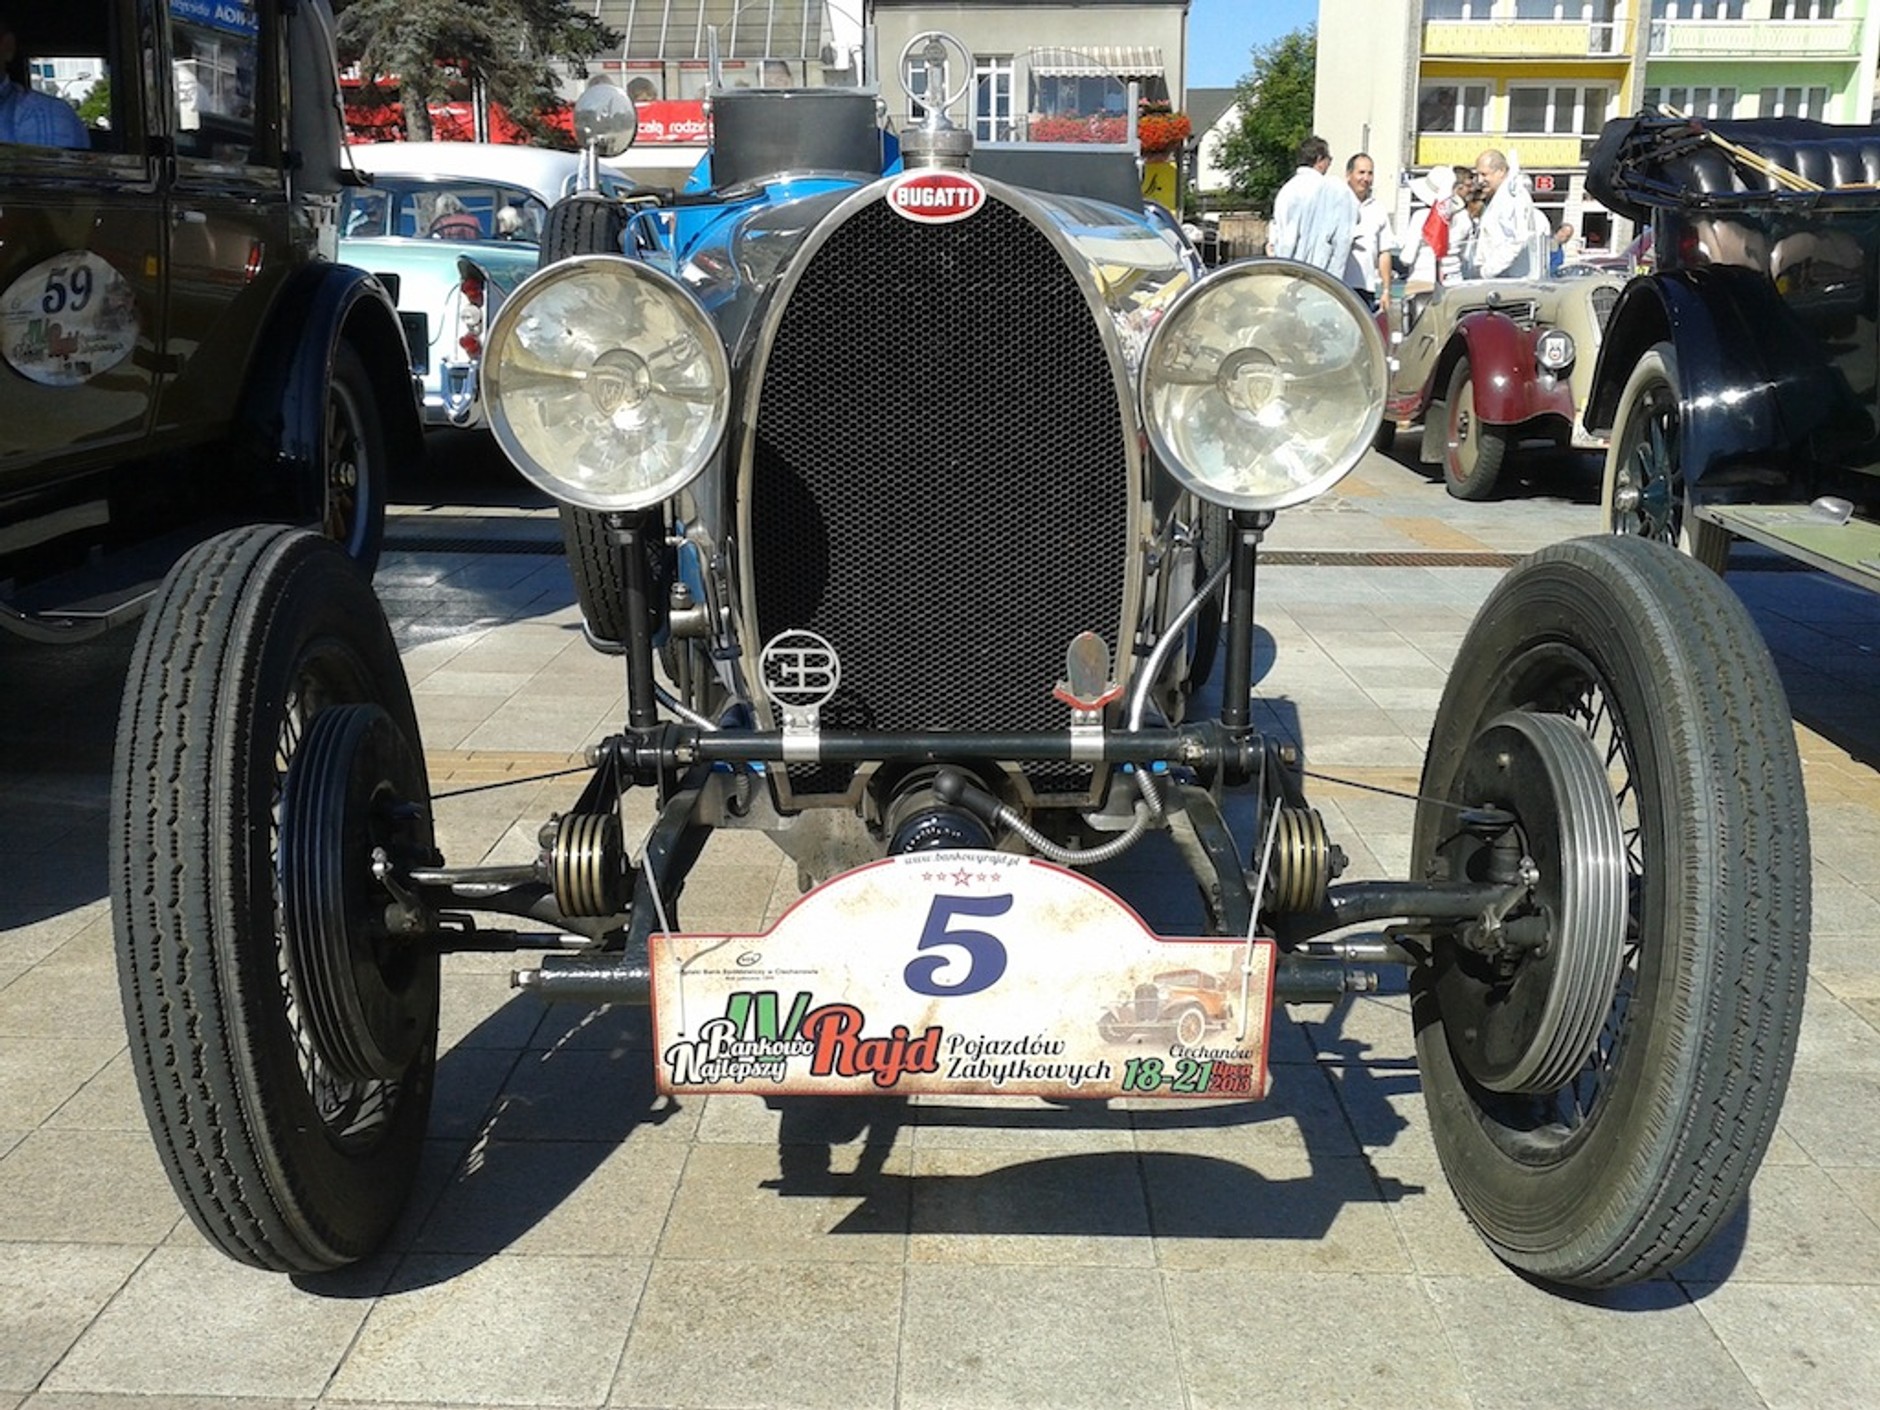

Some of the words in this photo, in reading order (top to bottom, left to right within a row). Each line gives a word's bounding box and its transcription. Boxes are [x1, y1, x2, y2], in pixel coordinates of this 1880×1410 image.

[897, 187, 974, 207] BUGATTI
[42, 265, 93, 314] 59
[904, 852, 1021, 867] www.bankowyrajd.pl
[903, 893, 1012, 996] 5
[698, 1017, 817, 1061] Bankowo
[801, 1003, 944, 1088] Rajd
[946, 1033, 1065, 1062] Pojazdów
[1168, 1042, 1254, 1059] Ciechanów
[664, 1041, 787, 1085] Najlepszy
[946, 1057, 1111, 1085] Zabytkowych
[1121, 1058, 1214, 1093] 18-21
[1209, 1075, 1252, 1092] 2013
